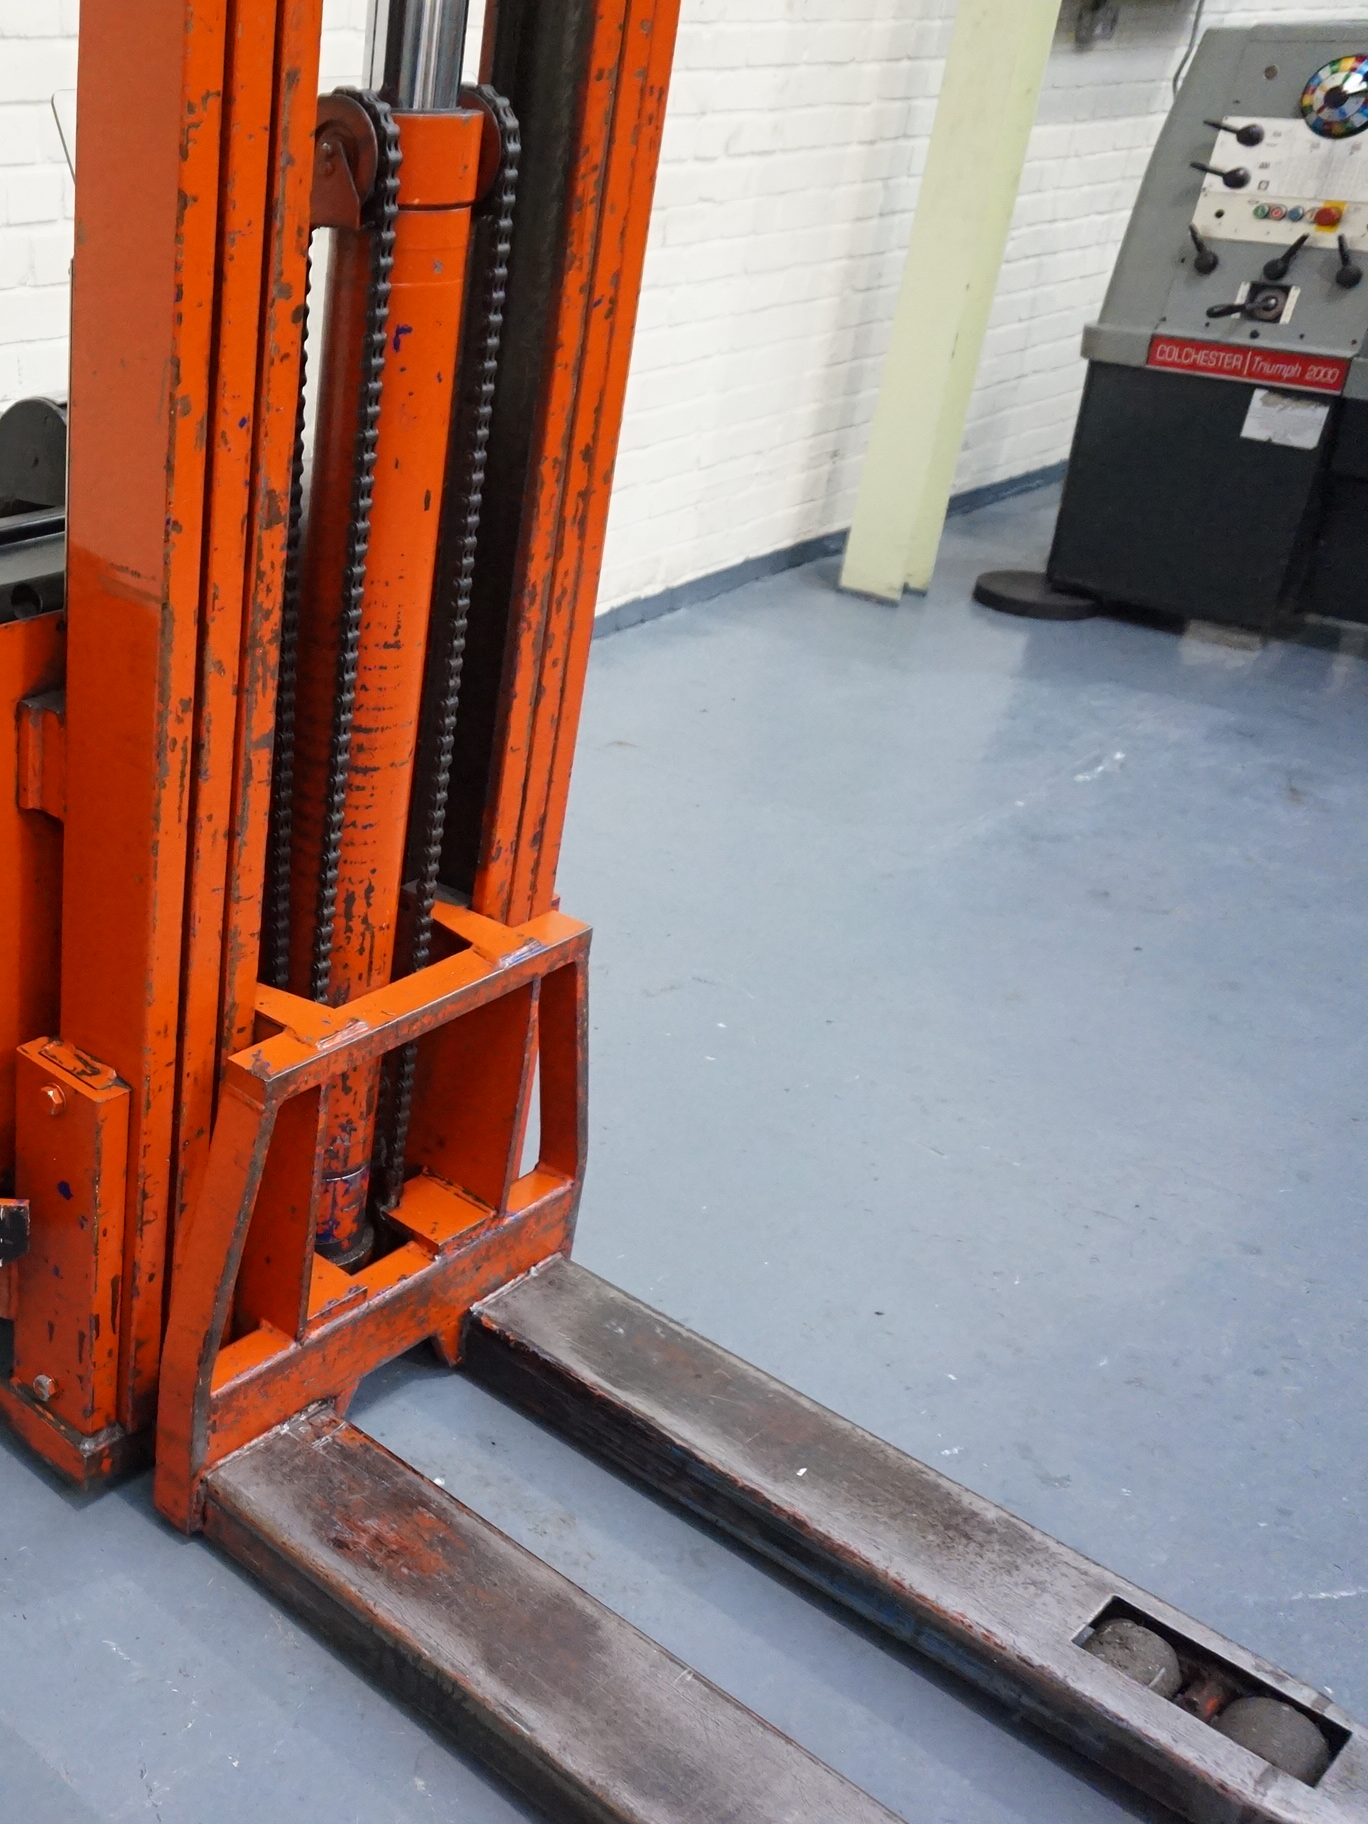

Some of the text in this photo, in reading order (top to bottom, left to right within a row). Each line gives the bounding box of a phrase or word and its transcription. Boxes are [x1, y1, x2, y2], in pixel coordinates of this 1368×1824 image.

[1155, 343, 1340, 384] COLCHESTER Triumph 2000
